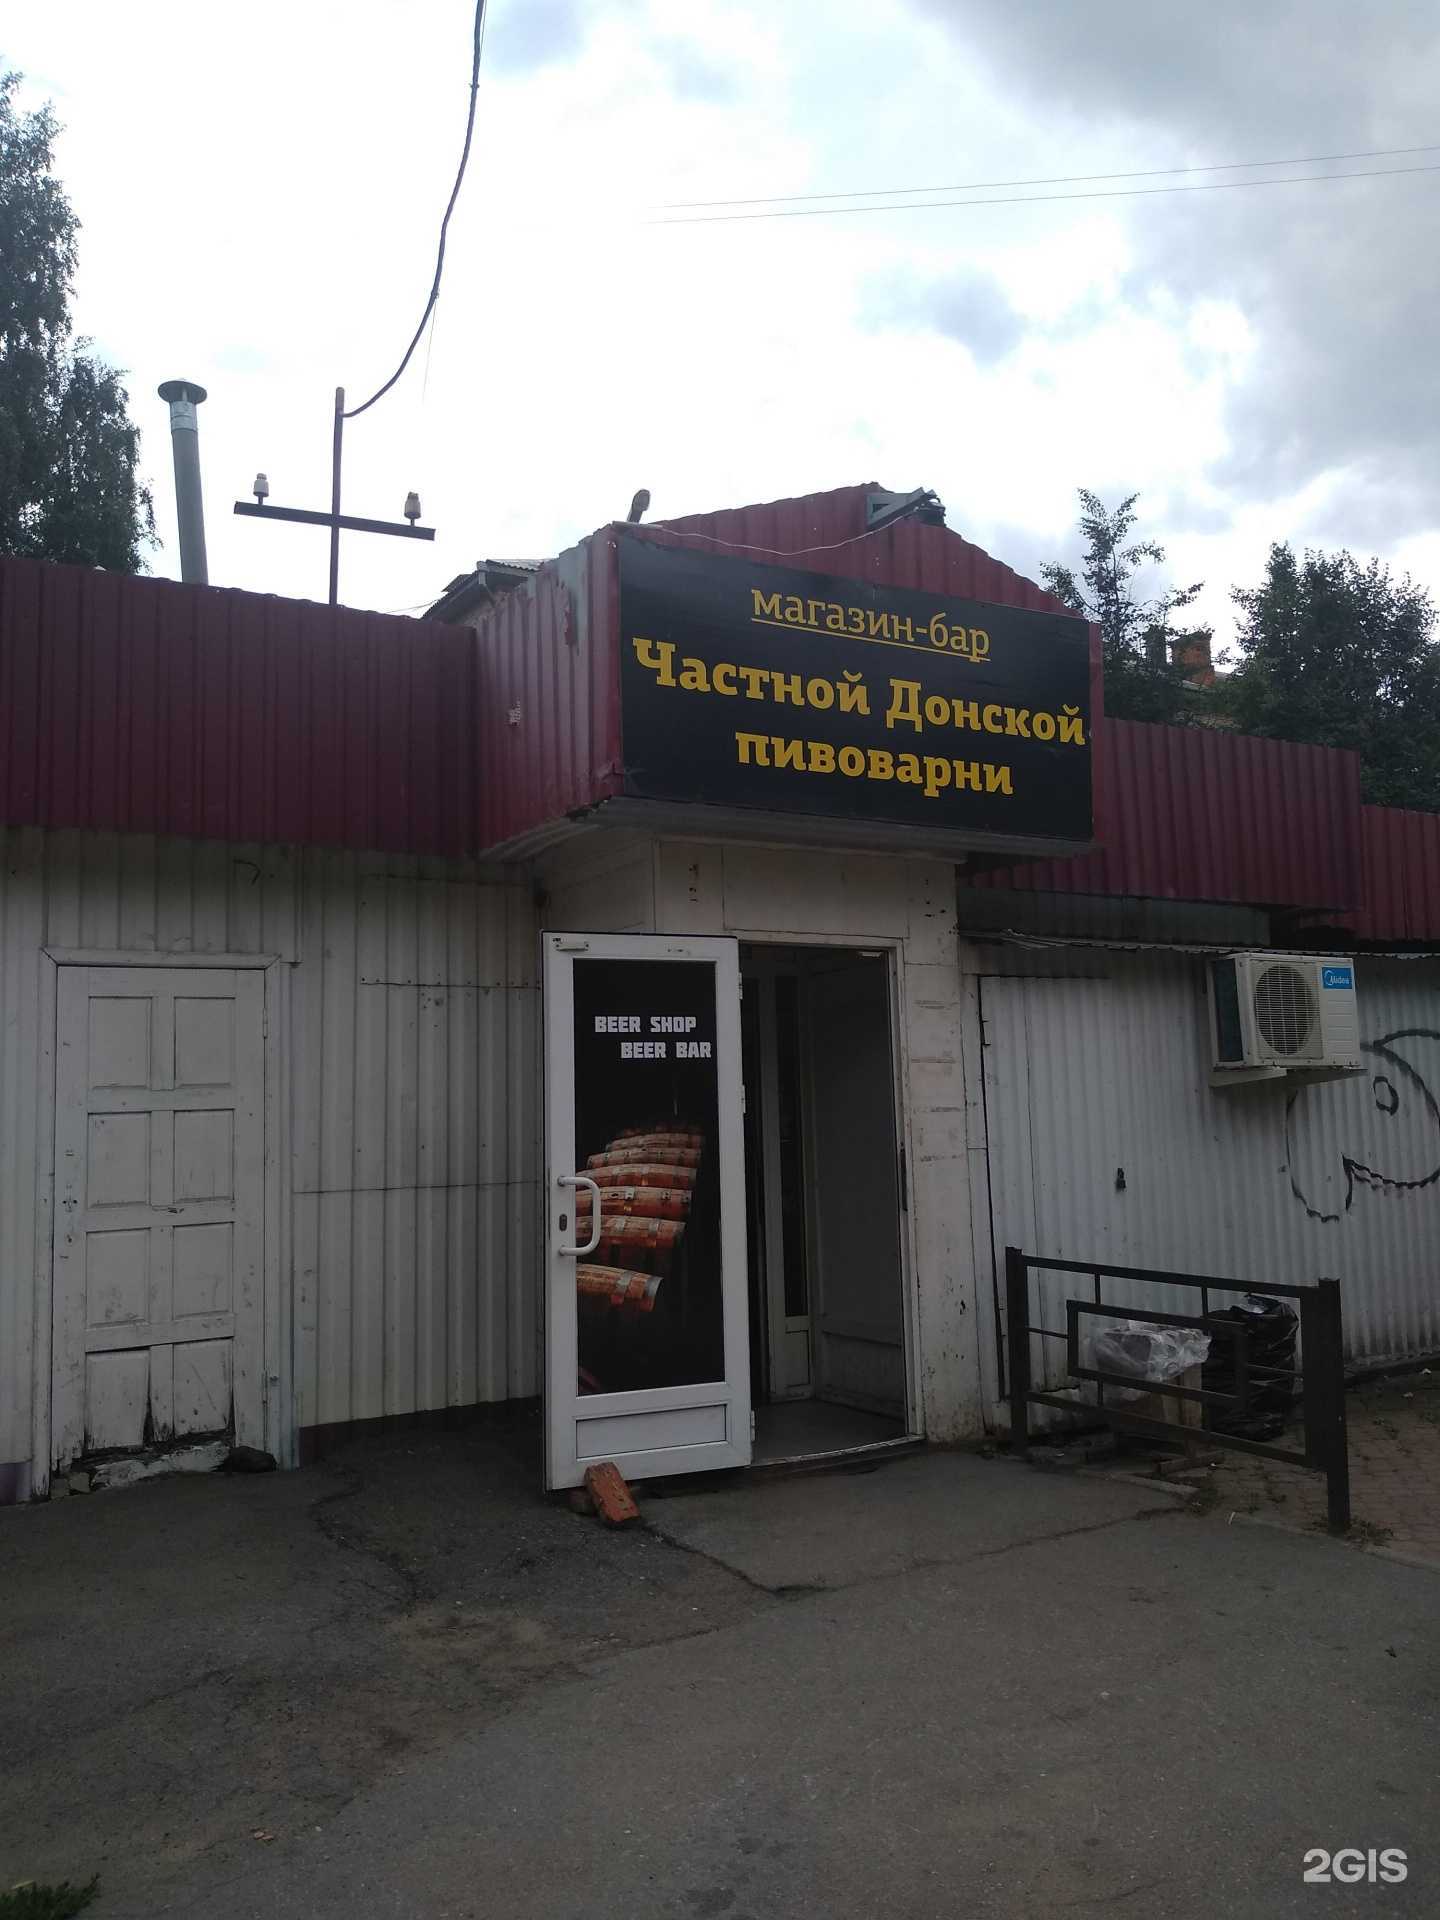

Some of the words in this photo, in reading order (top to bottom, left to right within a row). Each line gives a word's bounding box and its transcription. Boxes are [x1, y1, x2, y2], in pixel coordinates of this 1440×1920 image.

[751, 588, 991, 662] магазин-бар
[632, 637, 871, 717] Частной
[886, 678, 1087, 746] Донской
[735, 731, 1015, 797] пивоварни
[595, 1016, 641, 1033] BEER
[650, 1016, 696, 1033] SHOP
[621, 1042, 666, 1058] BEER
[676, 1042, 711, 1058] BAR
